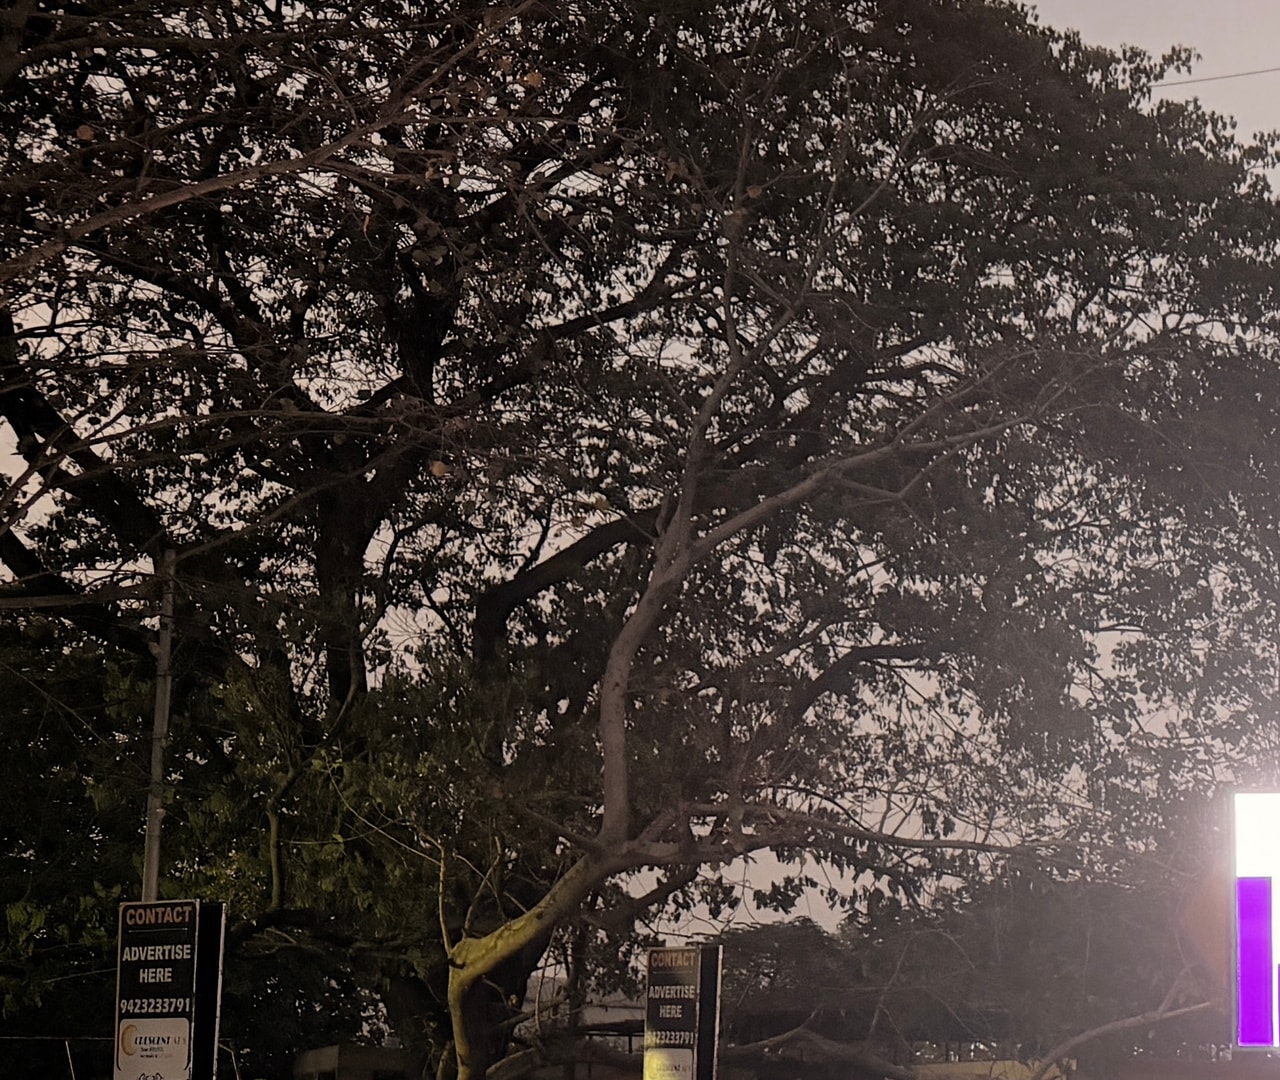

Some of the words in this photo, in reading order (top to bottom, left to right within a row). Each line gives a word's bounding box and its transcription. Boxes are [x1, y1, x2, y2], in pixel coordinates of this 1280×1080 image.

[125, 906, 192, 925] CONTACT
[122, 944, 192, 962] ADVERTISE
[650, 952, 695, 968] CONTACT
[138, 967, 173, 984] HERE
[648, 985, 696, 1000] ADVERTISE
[120, 997, 191, 1014] 9423233791
[658, 1005, 683, 1019] HERE
